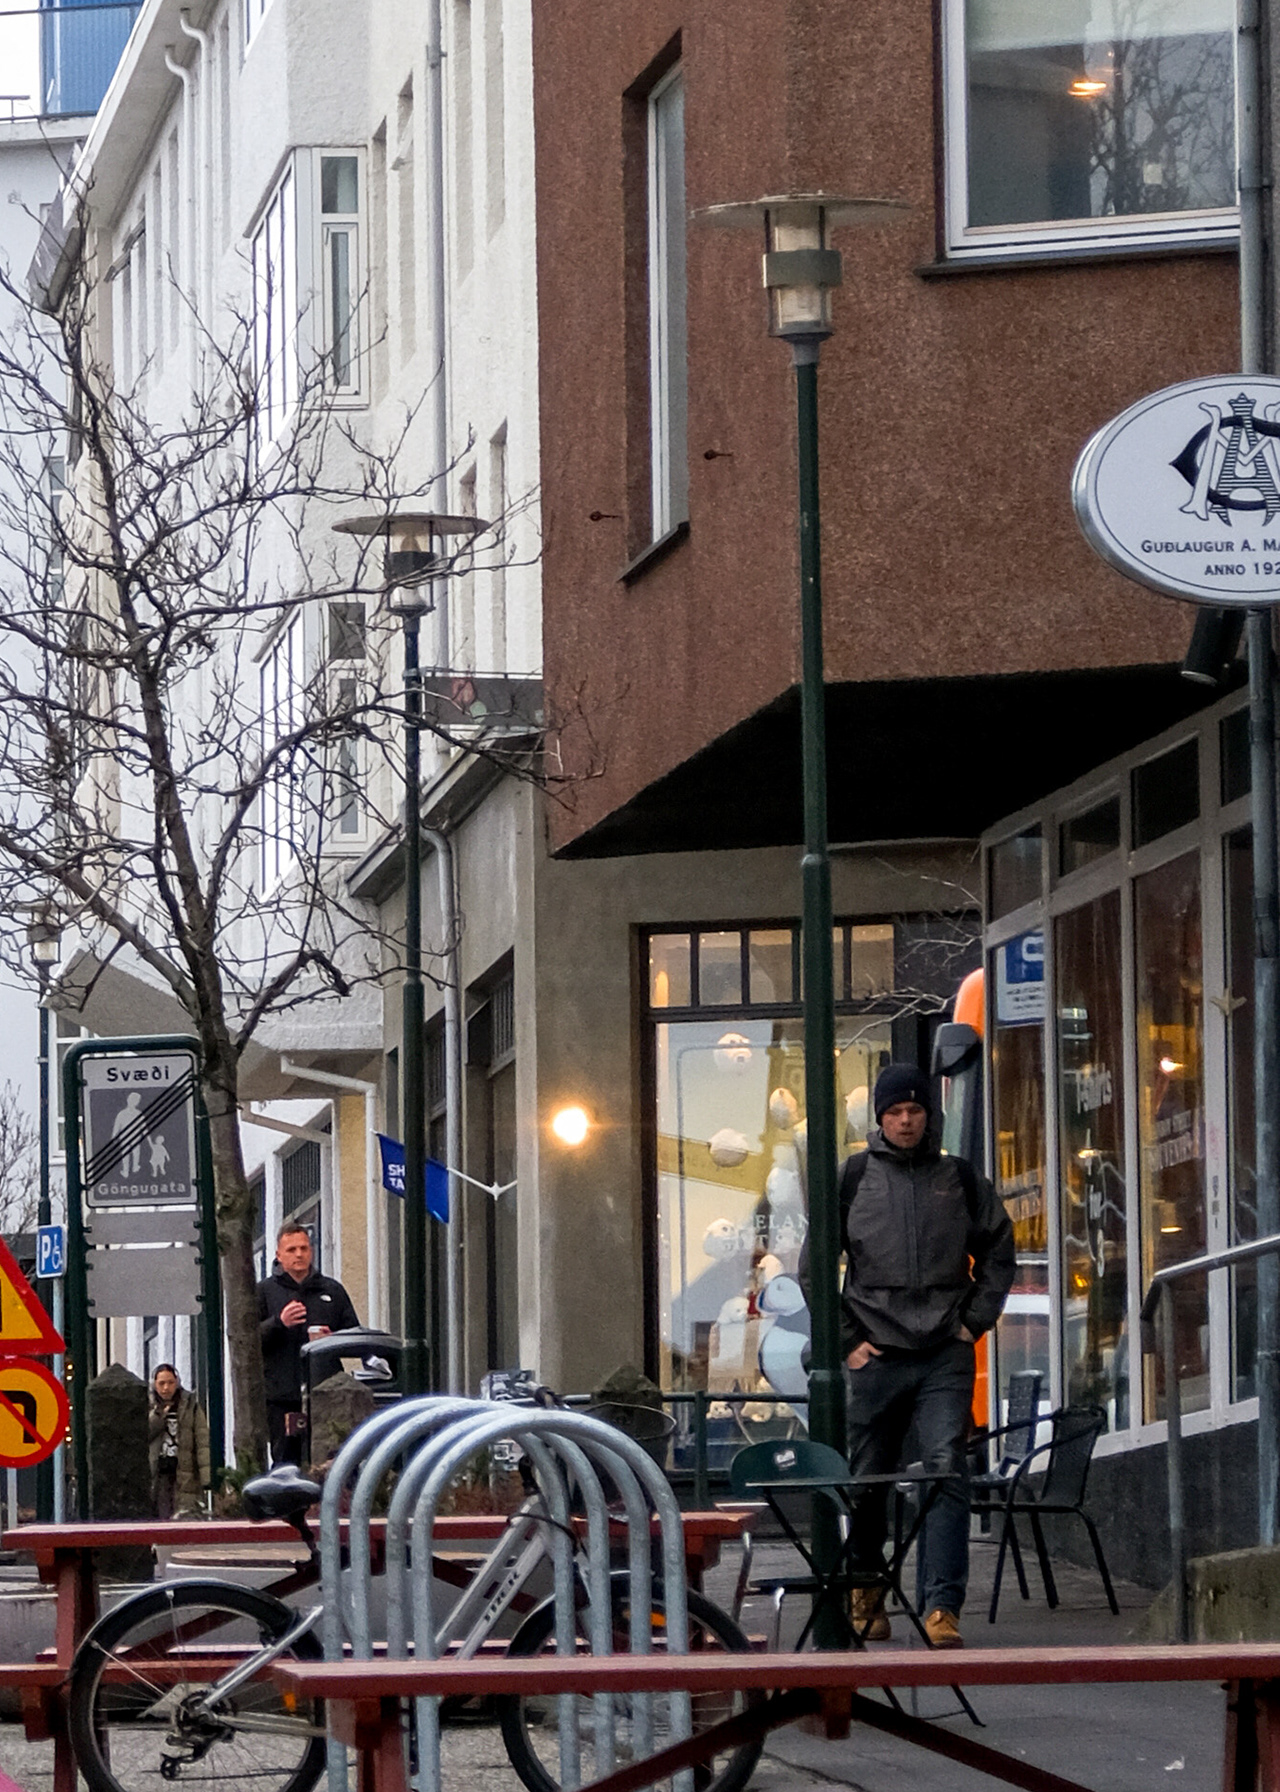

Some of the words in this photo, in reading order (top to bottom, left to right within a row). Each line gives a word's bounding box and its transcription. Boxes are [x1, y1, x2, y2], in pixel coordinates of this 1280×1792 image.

[1141, 539, 1235, 553] GUÐLAUGUR
[1241, 539, 1256, 552] A.
[1204, 564, 1246, 576] ANNO
[107, 1066, 169, 1082] Svæði
[98, 1182, 186, 1196] Göngugata
